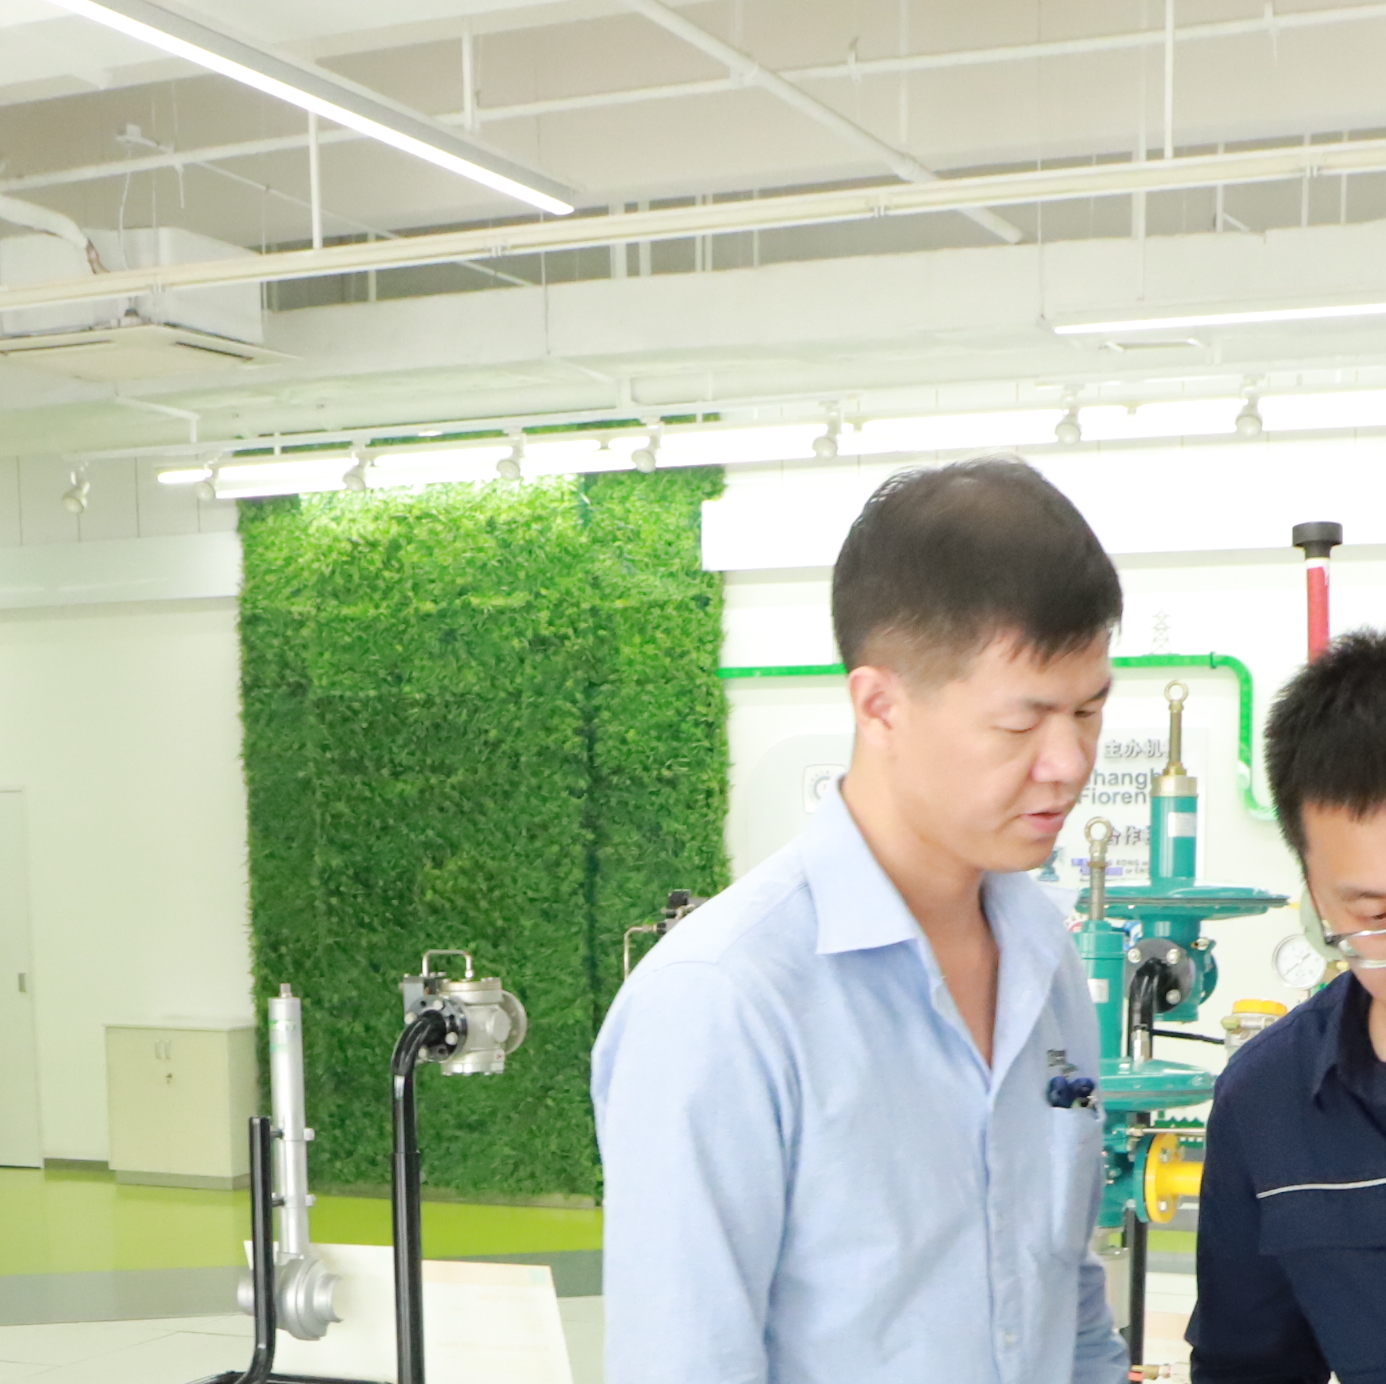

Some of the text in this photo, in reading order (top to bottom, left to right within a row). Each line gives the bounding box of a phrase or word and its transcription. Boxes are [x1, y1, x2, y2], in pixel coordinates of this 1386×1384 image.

[1104, 738, 1169, 759] 主办机
[1090, 767, 1162, 790] hangh
[1078, 787, 1150, 804] Fioren
